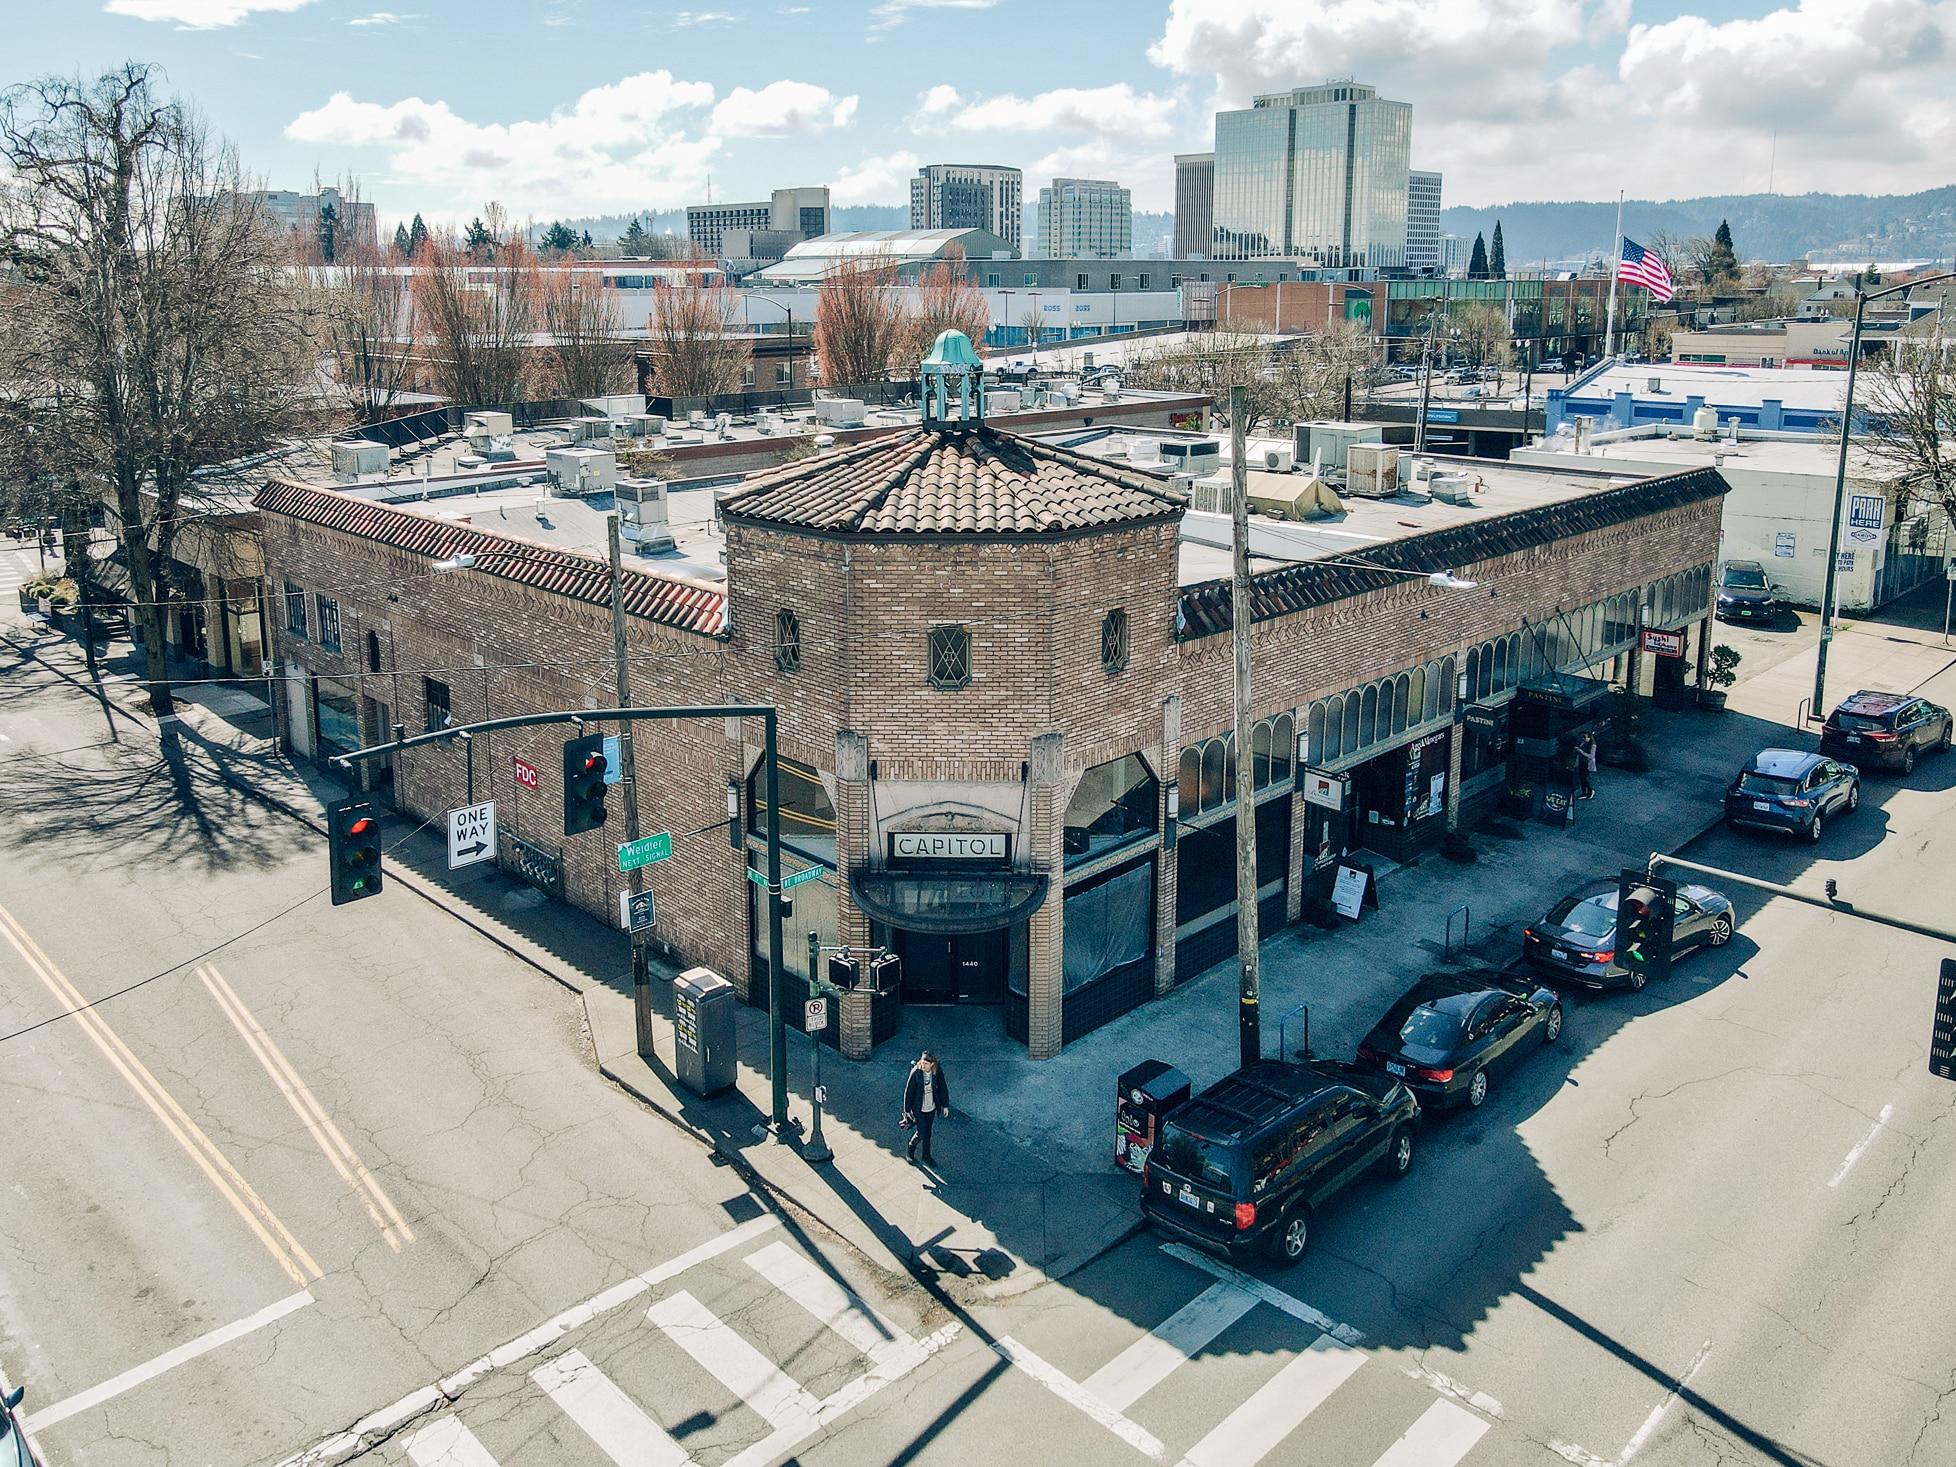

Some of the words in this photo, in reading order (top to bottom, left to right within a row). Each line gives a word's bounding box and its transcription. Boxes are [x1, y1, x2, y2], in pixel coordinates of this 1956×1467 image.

[1043, 304, 1061, 312] ROSS
[1813, 347, 1830, 355] Bank
[1851, 497, 1882, 521] PARK
[1850, 519, 1880, 528] HERE
[1647, 633, 1669, 643] Sushi
[1528, 691, 1562, 703] PASTINI
[1466, 714, 1494, 727] PASTINI
[515, 763, 537, 786] FDC
[457, 807, 488, 827] ONE
[456, 822, 489, 842] WAY
[626, 839, 663, 857] Weidler
[899, 837, 1001, 856] CAPITOL
[622, 857, 640, 868] NEXT
[645, 848, 669, 862] SIGNAL
[784, 879, 791, 888] NE
[794, 868, 823, 884] BROADWAY
